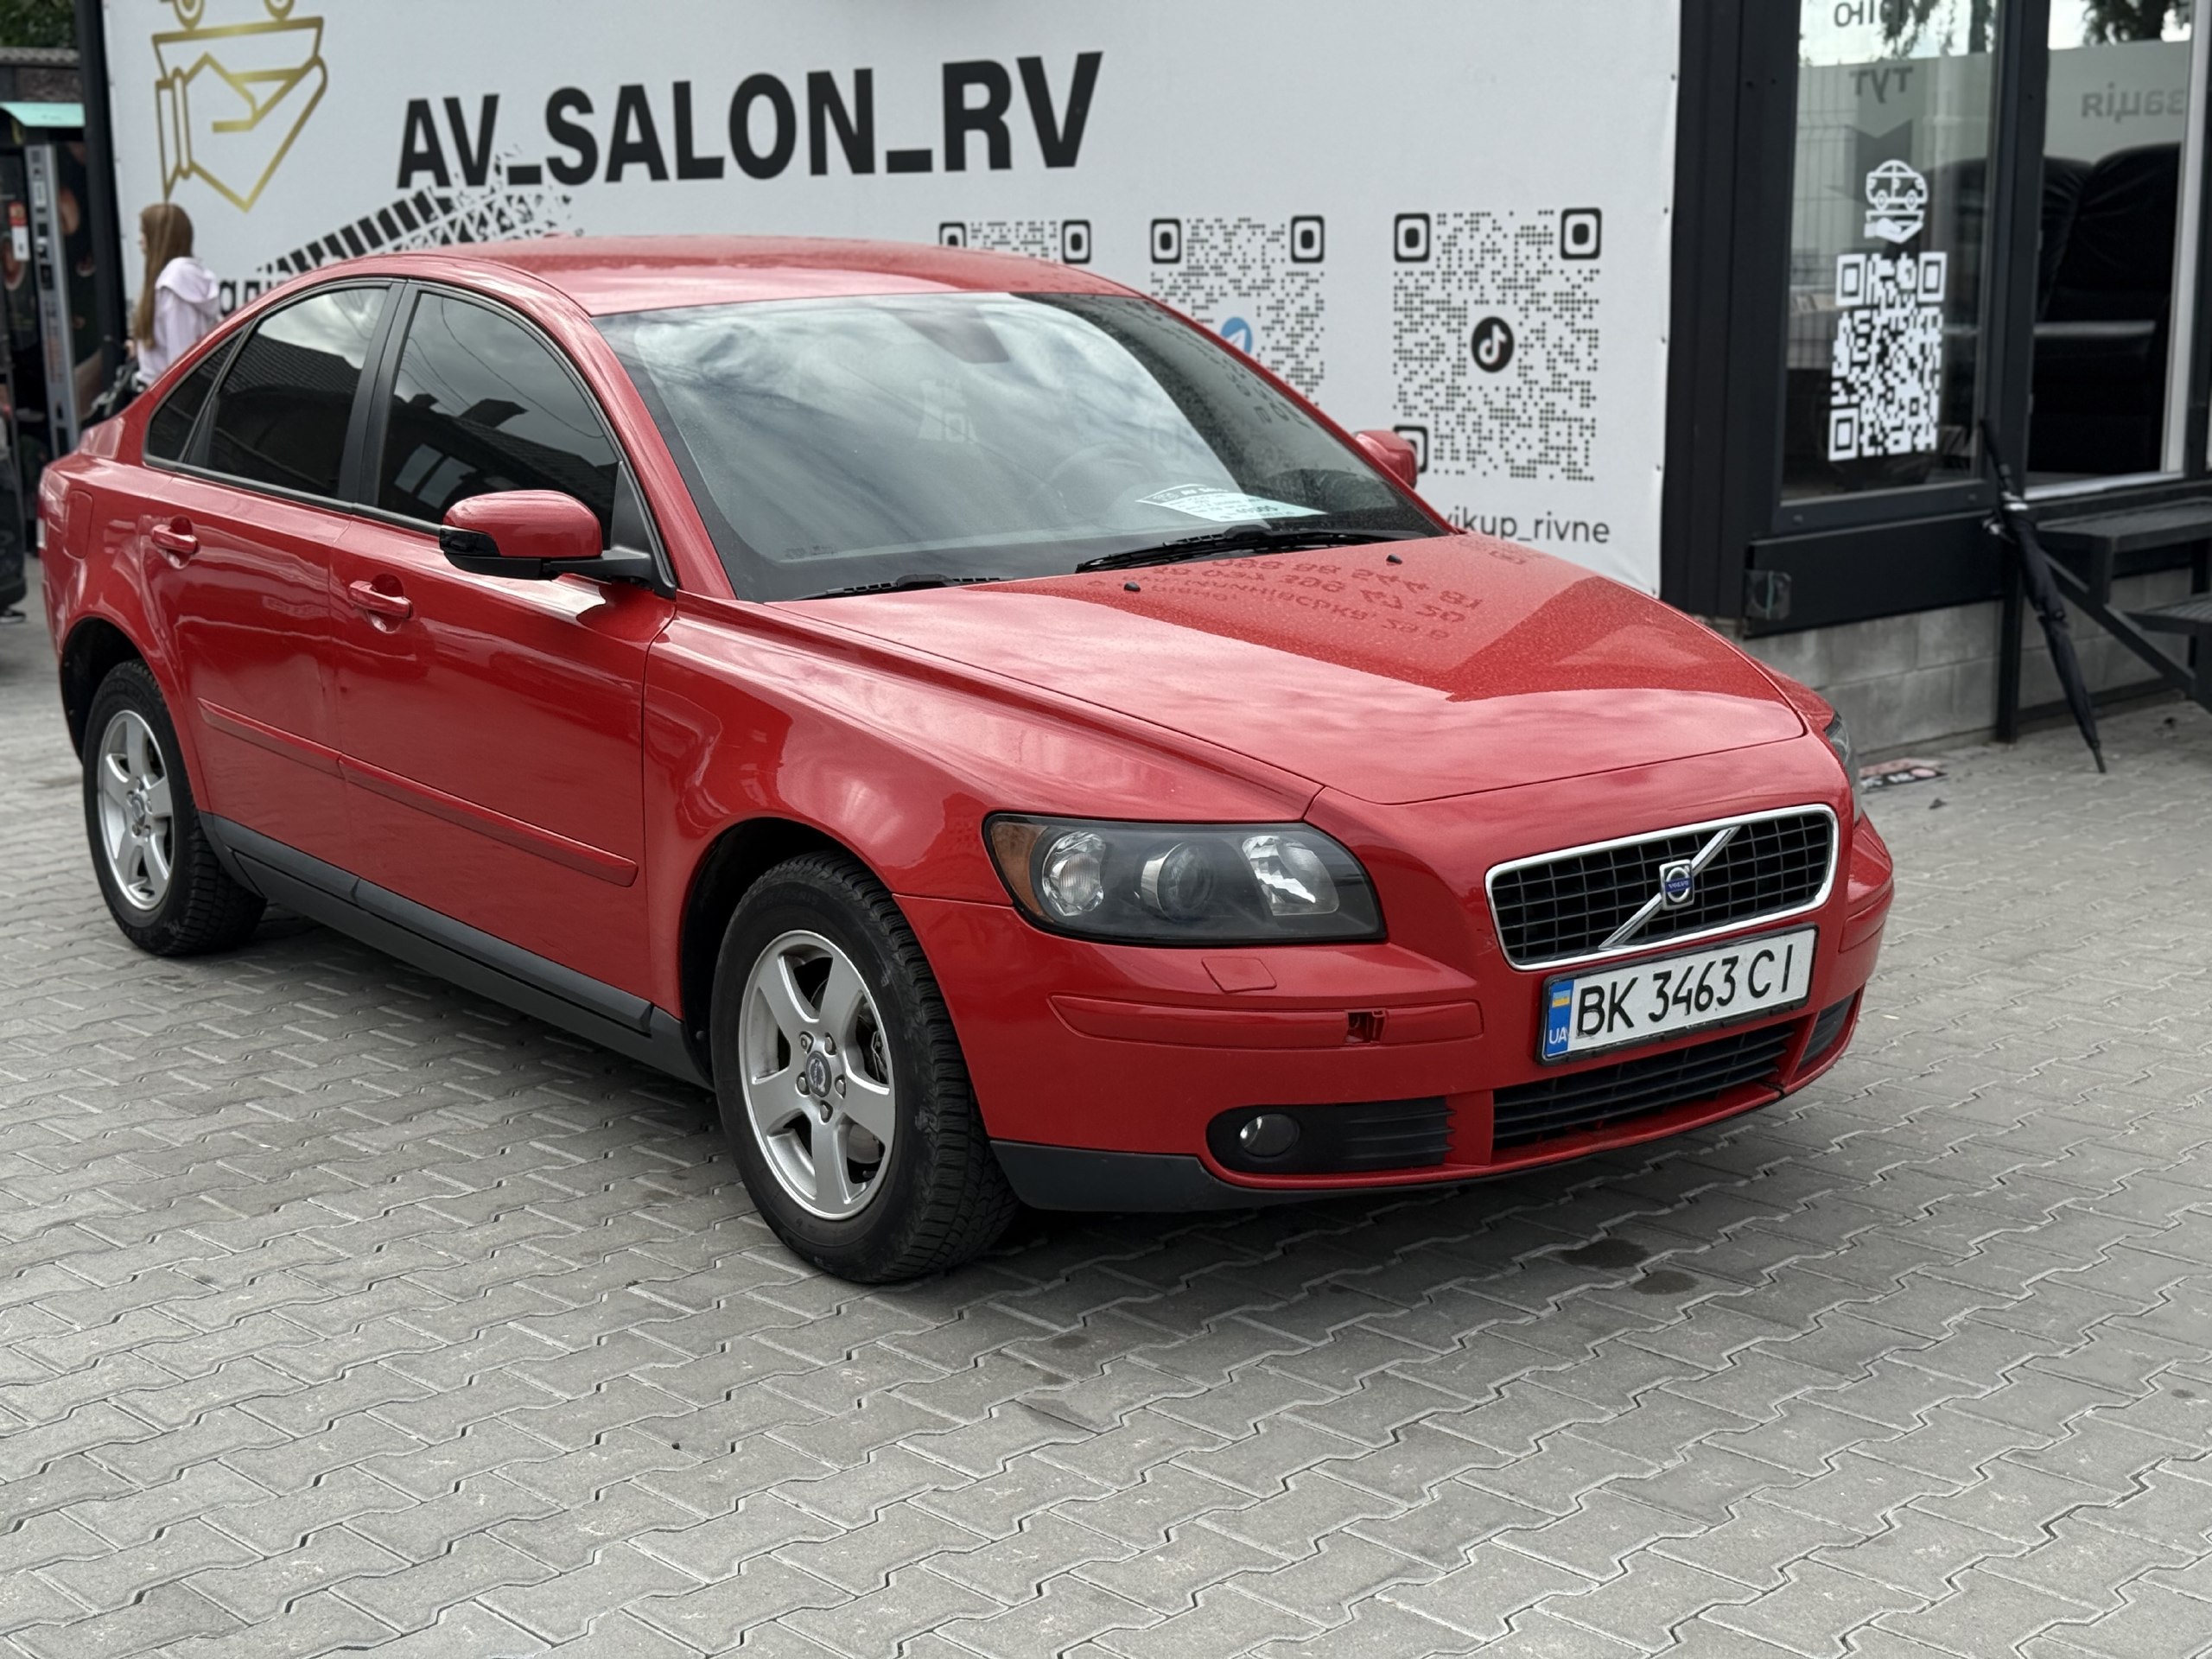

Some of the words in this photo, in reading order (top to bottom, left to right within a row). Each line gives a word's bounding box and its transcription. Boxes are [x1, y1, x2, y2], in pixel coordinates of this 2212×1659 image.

[397, 50, 1104, 189] AV_SALON_RV
[1548, 1027, 1567, 1046] UA
[1576, 976, 1639, 1037] BK
[1648, 955, 1739, 1023] 3463
